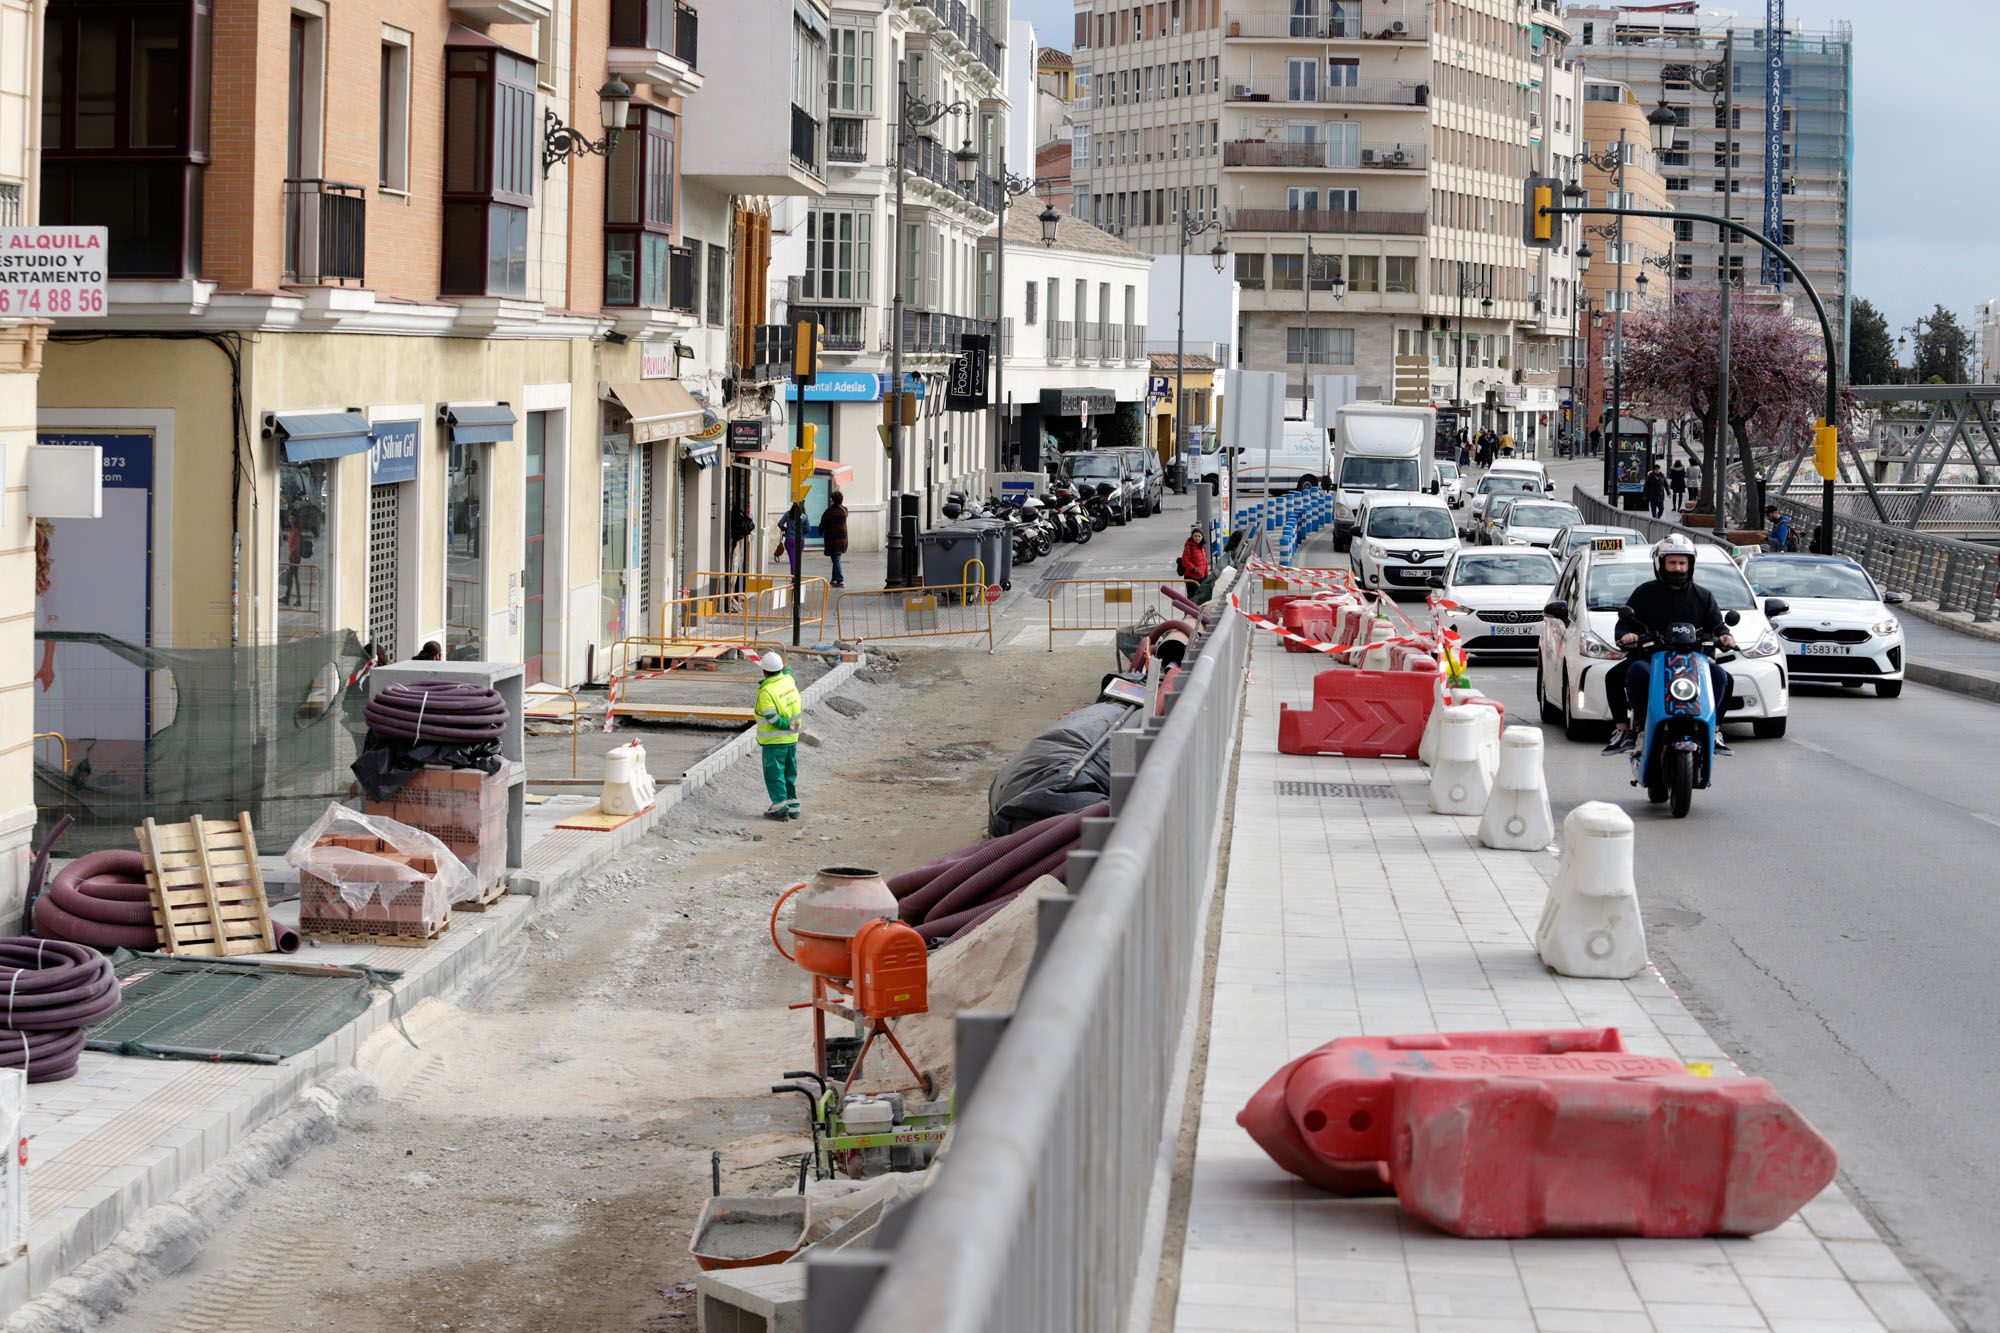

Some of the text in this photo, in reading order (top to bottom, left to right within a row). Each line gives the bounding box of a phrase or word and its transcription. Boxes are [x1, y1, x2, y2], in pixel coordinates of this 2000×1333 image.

[1771, 135, 1780, 229] CONSTRUCTORA
[9, 234, 100, 249] ALQUILA
[73, 255, 84, 267] Y
[16, 288, 41, 312] 74
[48, 288, 71, 312] 88
[79, 288, 102, 312] 56
[957, 352, 969, 394] POSADA
[834, 381, 866, 393] Adeslas
[1153, 377, 1165, 391] P
[382, 432, 415, 460] Silvia Gil
[103, 457, 126, 468] 873
[1806, 645, 1831, 654] 5583
[895, 1133, 921, 1143] MES
